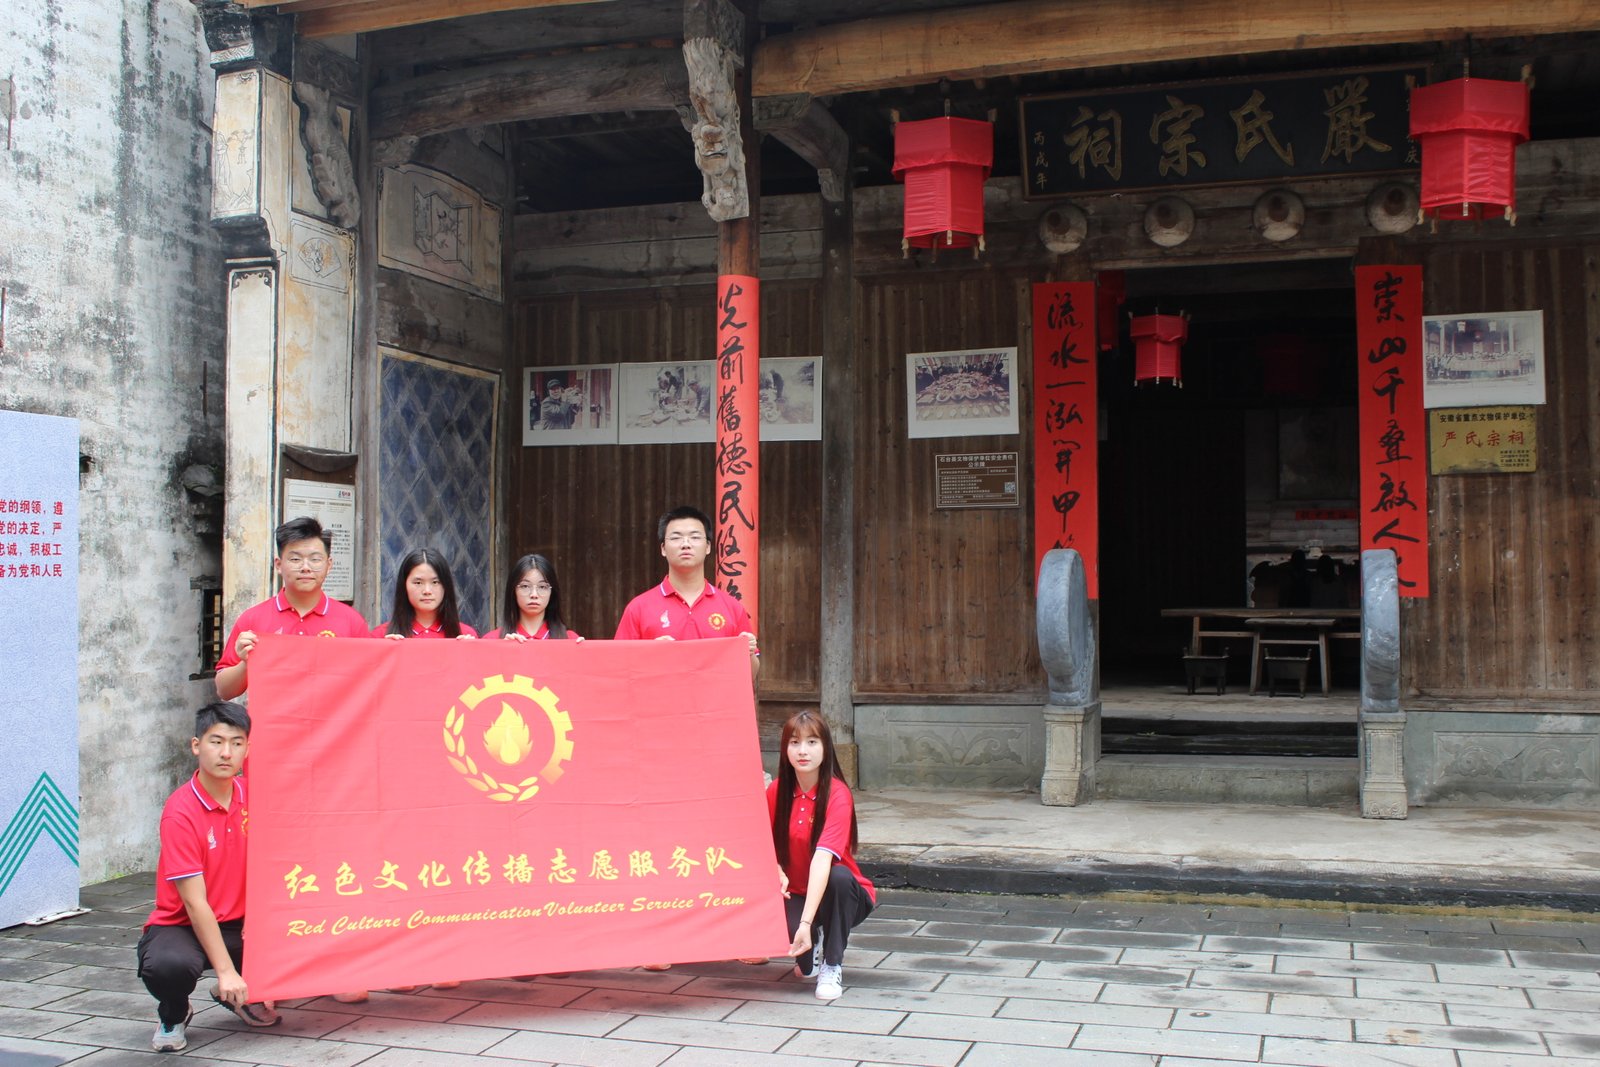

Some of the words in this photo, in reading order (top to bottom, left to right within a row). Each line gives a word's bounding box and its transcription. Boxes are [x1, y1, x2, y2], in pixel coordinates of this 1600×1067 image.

[1442, 430, 1525, 447] 严氏宗祠
[284, 846, 744, 899] 红色文化传播志愿服务队
[287, 919, 327, 936] Red
[331, 915, 401, 935] Culture
[407, 904, 542, 929] Communication
[543, 899, 625, 917] Volunteer
[630, 897, 694, 912] Service
[699, 892, 745, 908] Team
